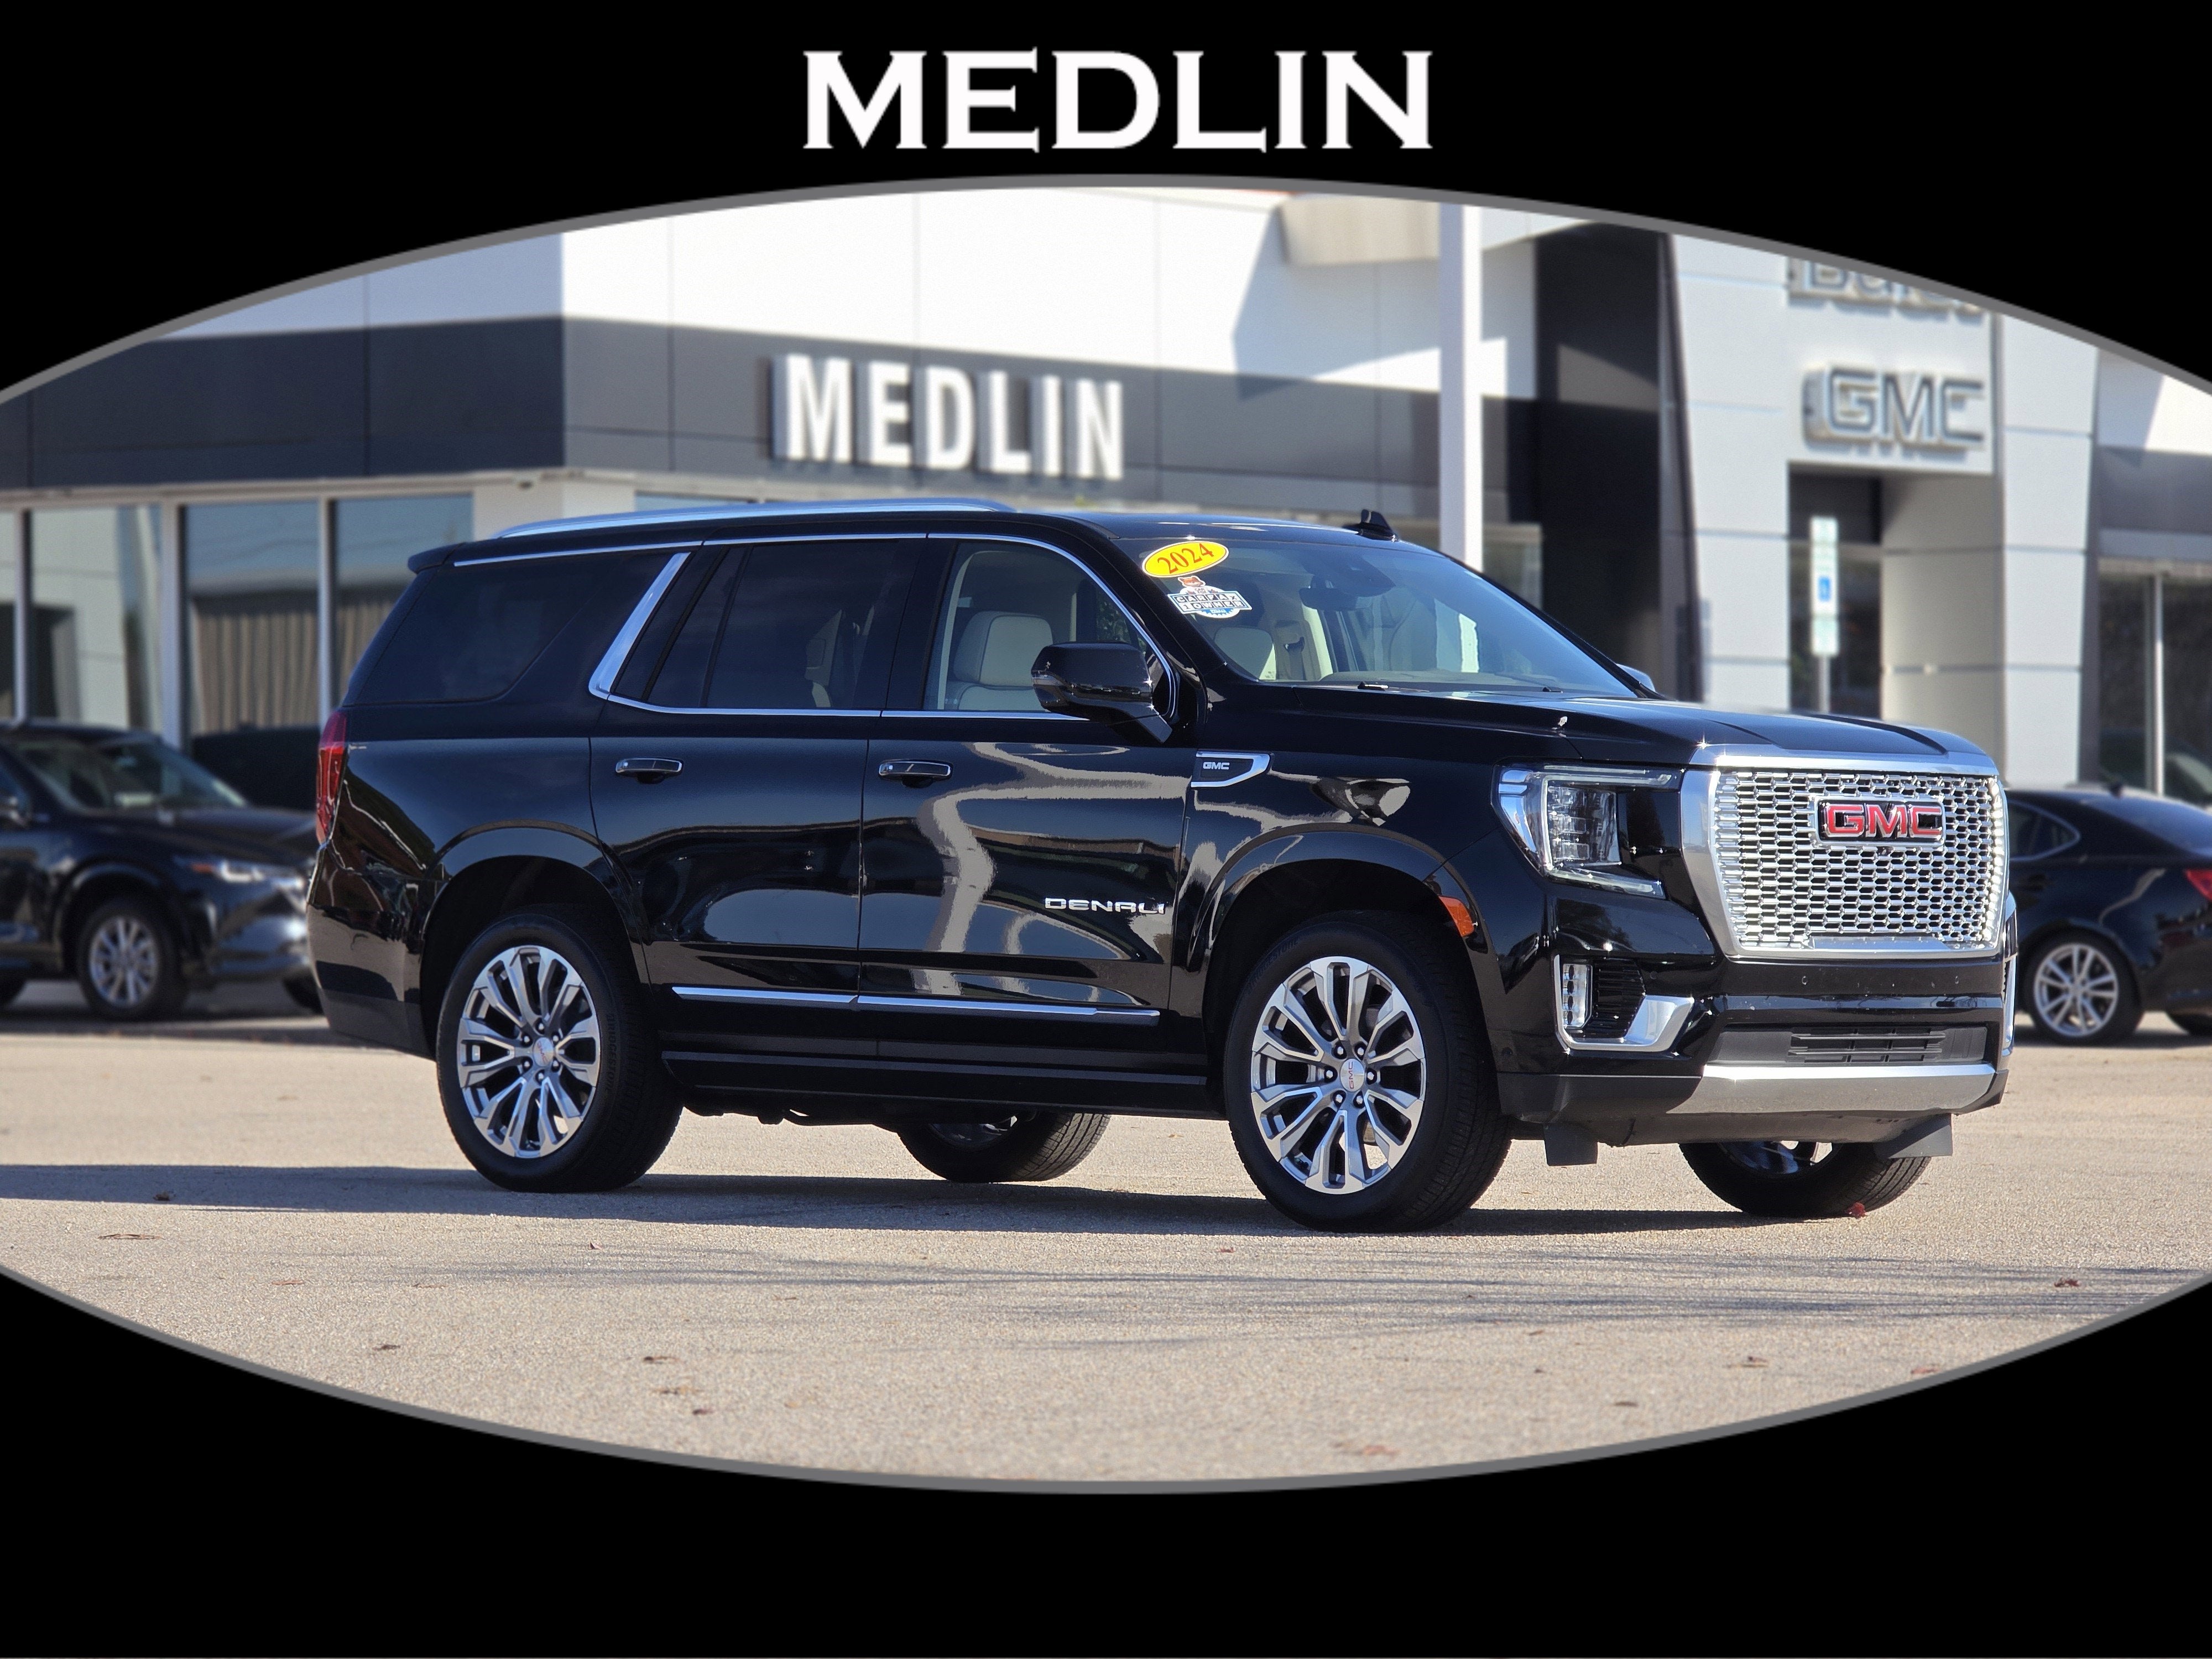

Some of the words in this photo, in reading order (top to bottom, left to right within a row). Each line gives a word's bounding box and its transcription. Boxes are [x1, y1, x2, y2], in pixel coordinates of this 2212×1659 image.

[781, 352, 1124, 481] MEDLIN
[1824, 364, 1986, 444] GMC
[1157, 542, 1215, 574] 2024
[1175, 593, 1238, 603] CARFAX
[1192, 601, 1245, 609] OWNER
[1203, 761, 1230, 770] GMC
[1825, 803, 1943, 838] GMC
[1045, 897, 1165, 915] DENALI
